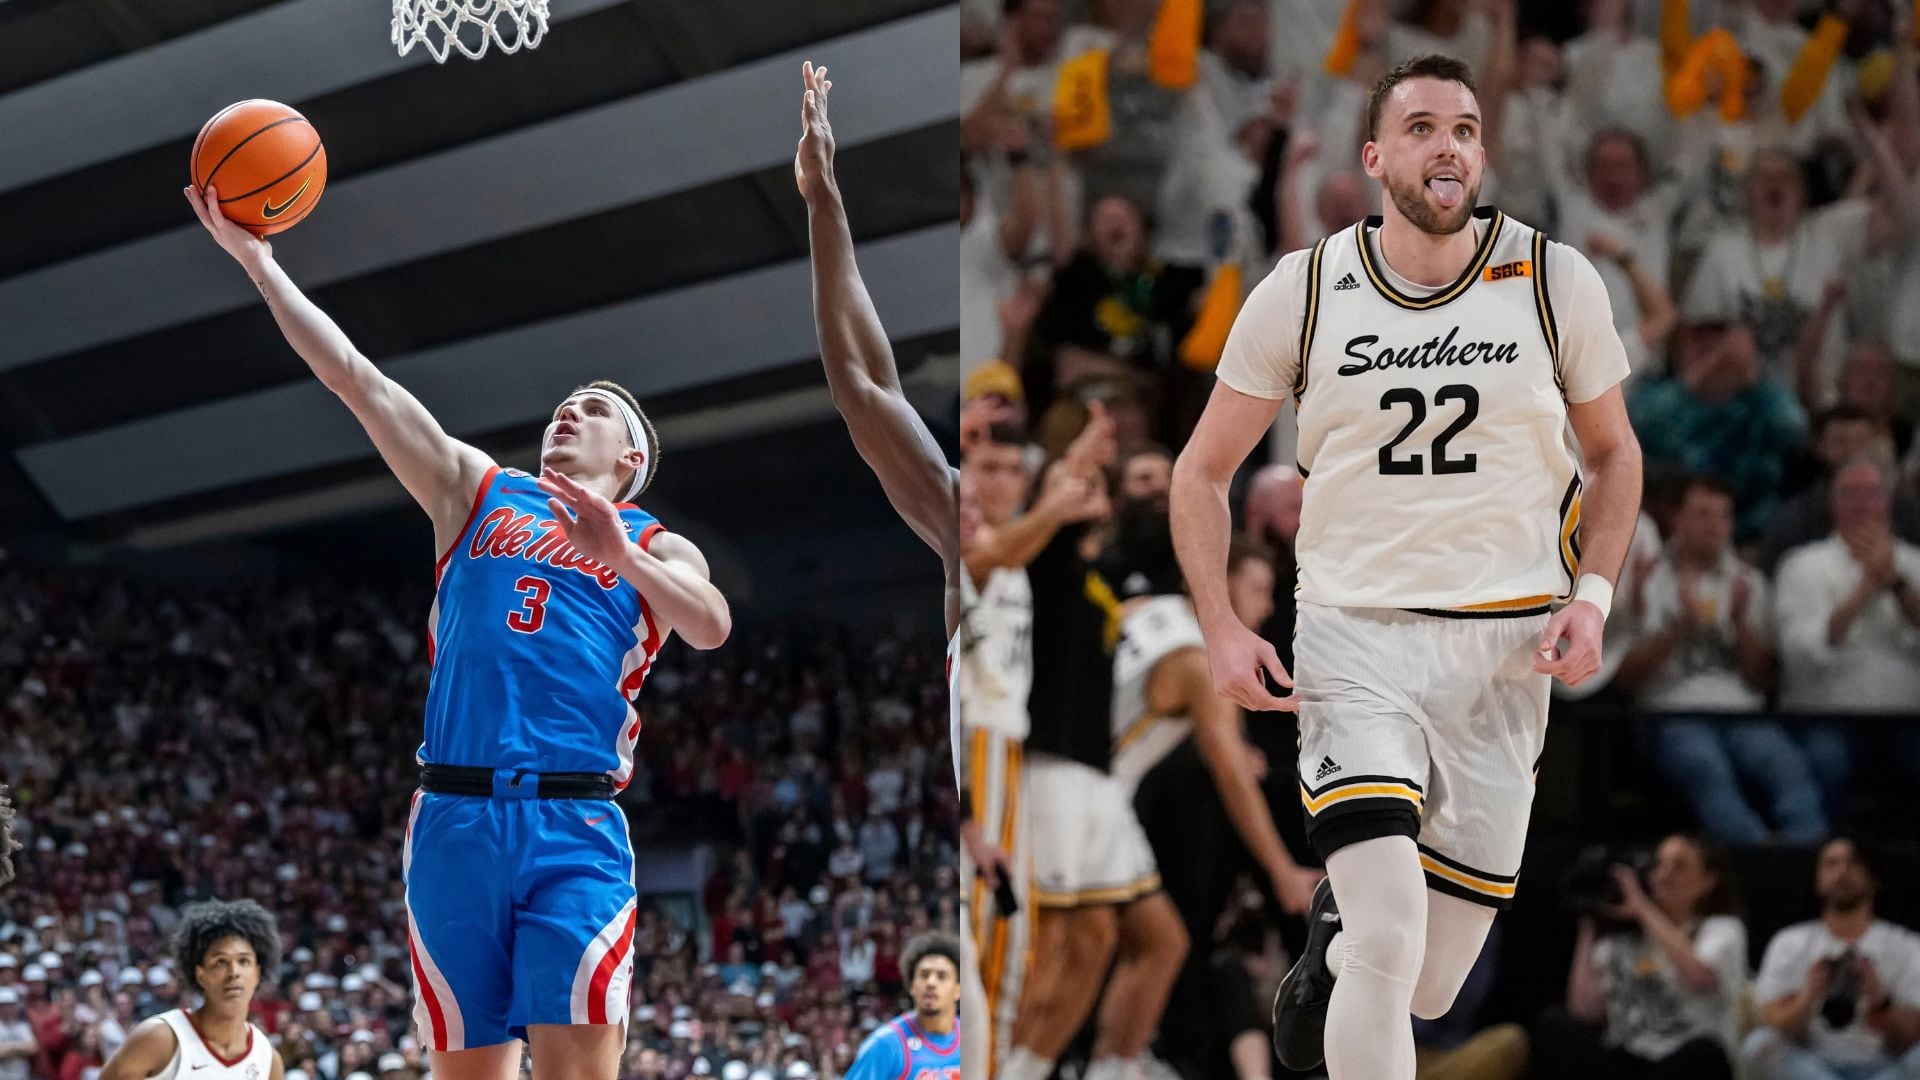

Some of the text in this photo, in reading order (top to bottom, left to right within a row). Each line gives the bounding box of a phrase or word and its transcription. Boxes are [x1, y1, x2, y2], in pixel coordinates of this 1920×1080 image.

[1334, 282, 1361, 291] adidas
[1491, 261, 1524, 280] SBC
[1337, 326, 1519, 377] Southern
[1379, 384, 1480, 475] 22
[469, 506, 537, 560] Ole
[506, 575, 552, 634] 3
[1316, 765, 1342, 781] adidas
